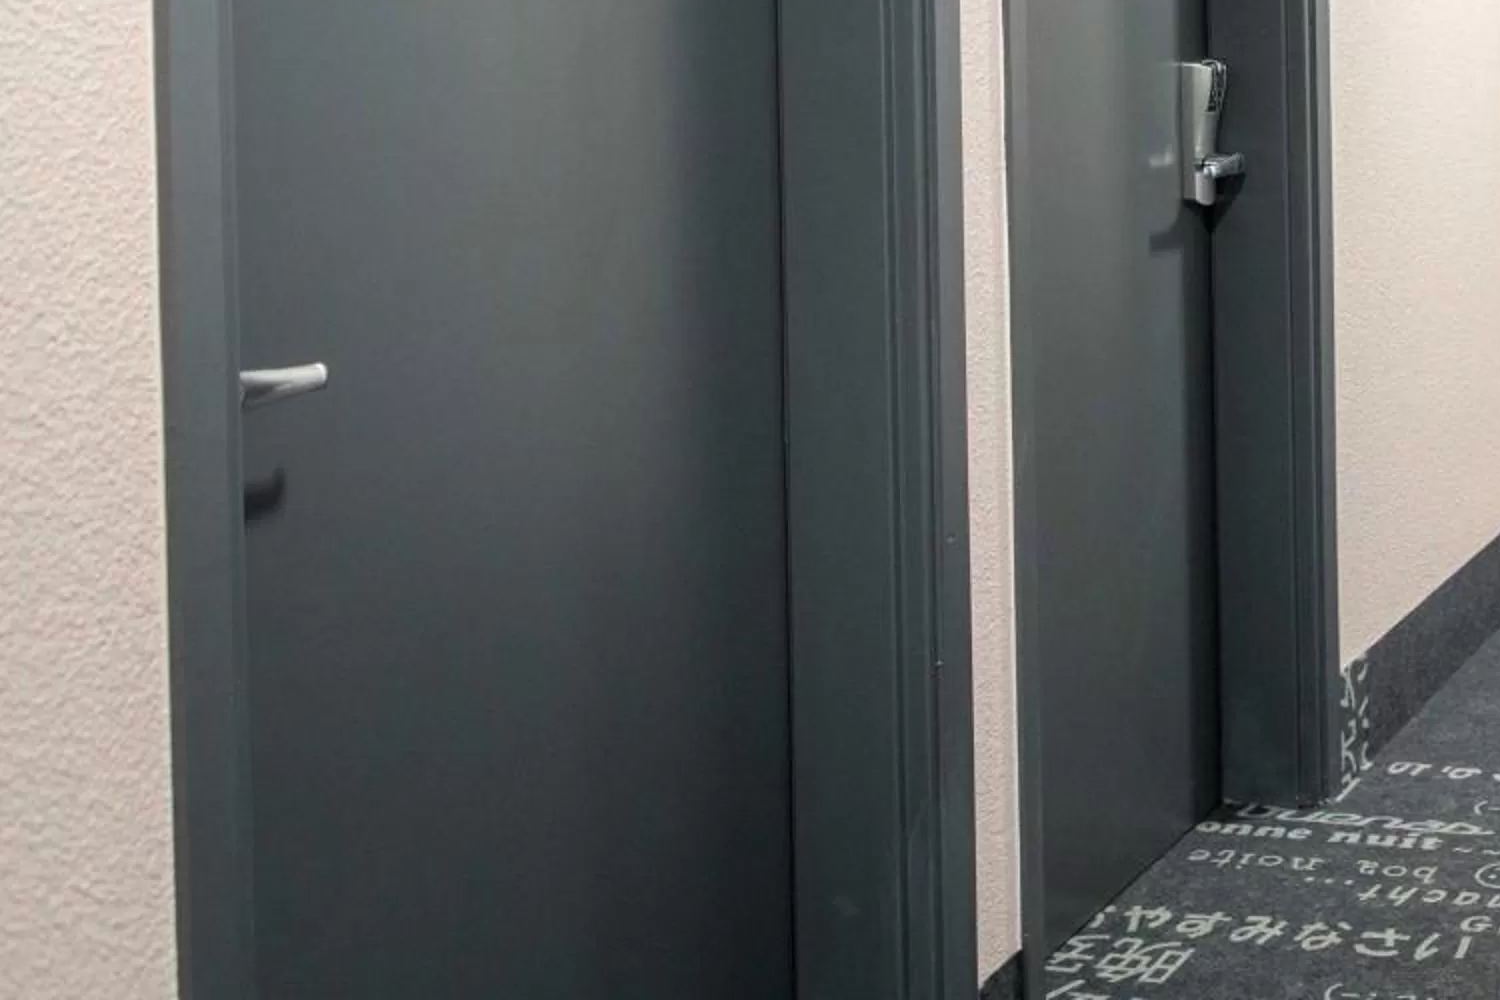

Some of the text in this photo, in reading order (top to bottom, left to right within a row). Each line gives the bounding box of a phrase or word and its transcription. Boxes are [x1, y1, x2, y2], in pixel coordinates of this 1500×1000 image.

[1188, 846, 1438, 884] boa noite
[1090, 903, 1474, 961] やすみなさい
